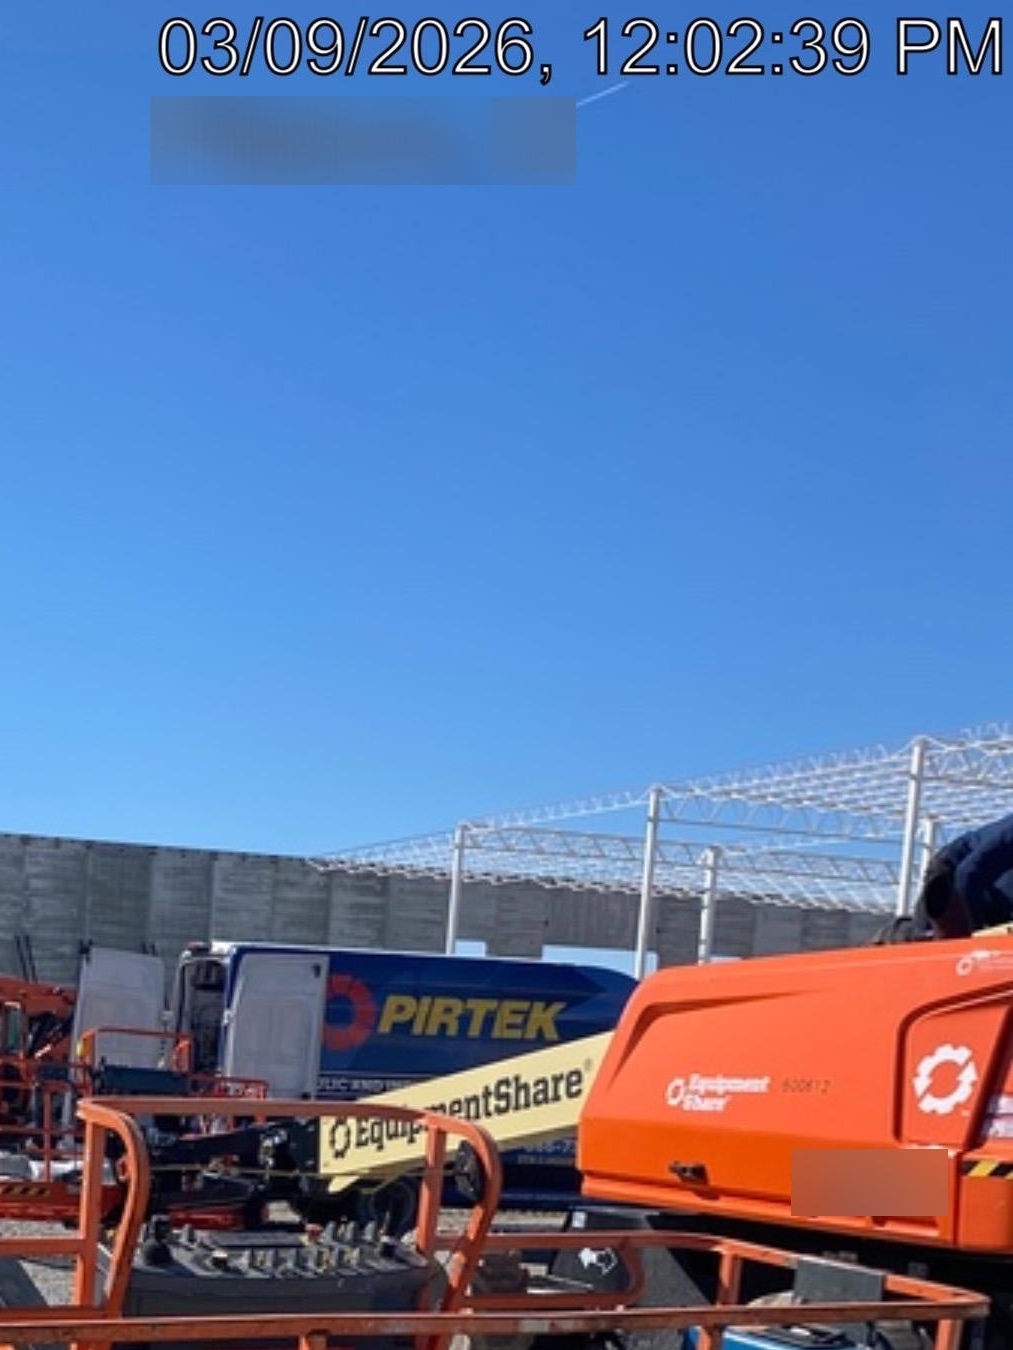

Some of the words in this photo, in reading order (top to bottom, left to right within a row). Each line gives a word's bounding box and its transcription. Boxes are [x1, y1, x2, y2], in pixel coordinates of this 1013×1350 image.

[379, 995, 566, 1040] PIRTEK
[690, 1073, 771, 1094] Equipment
[683, 1094, 730, 1112] Share
